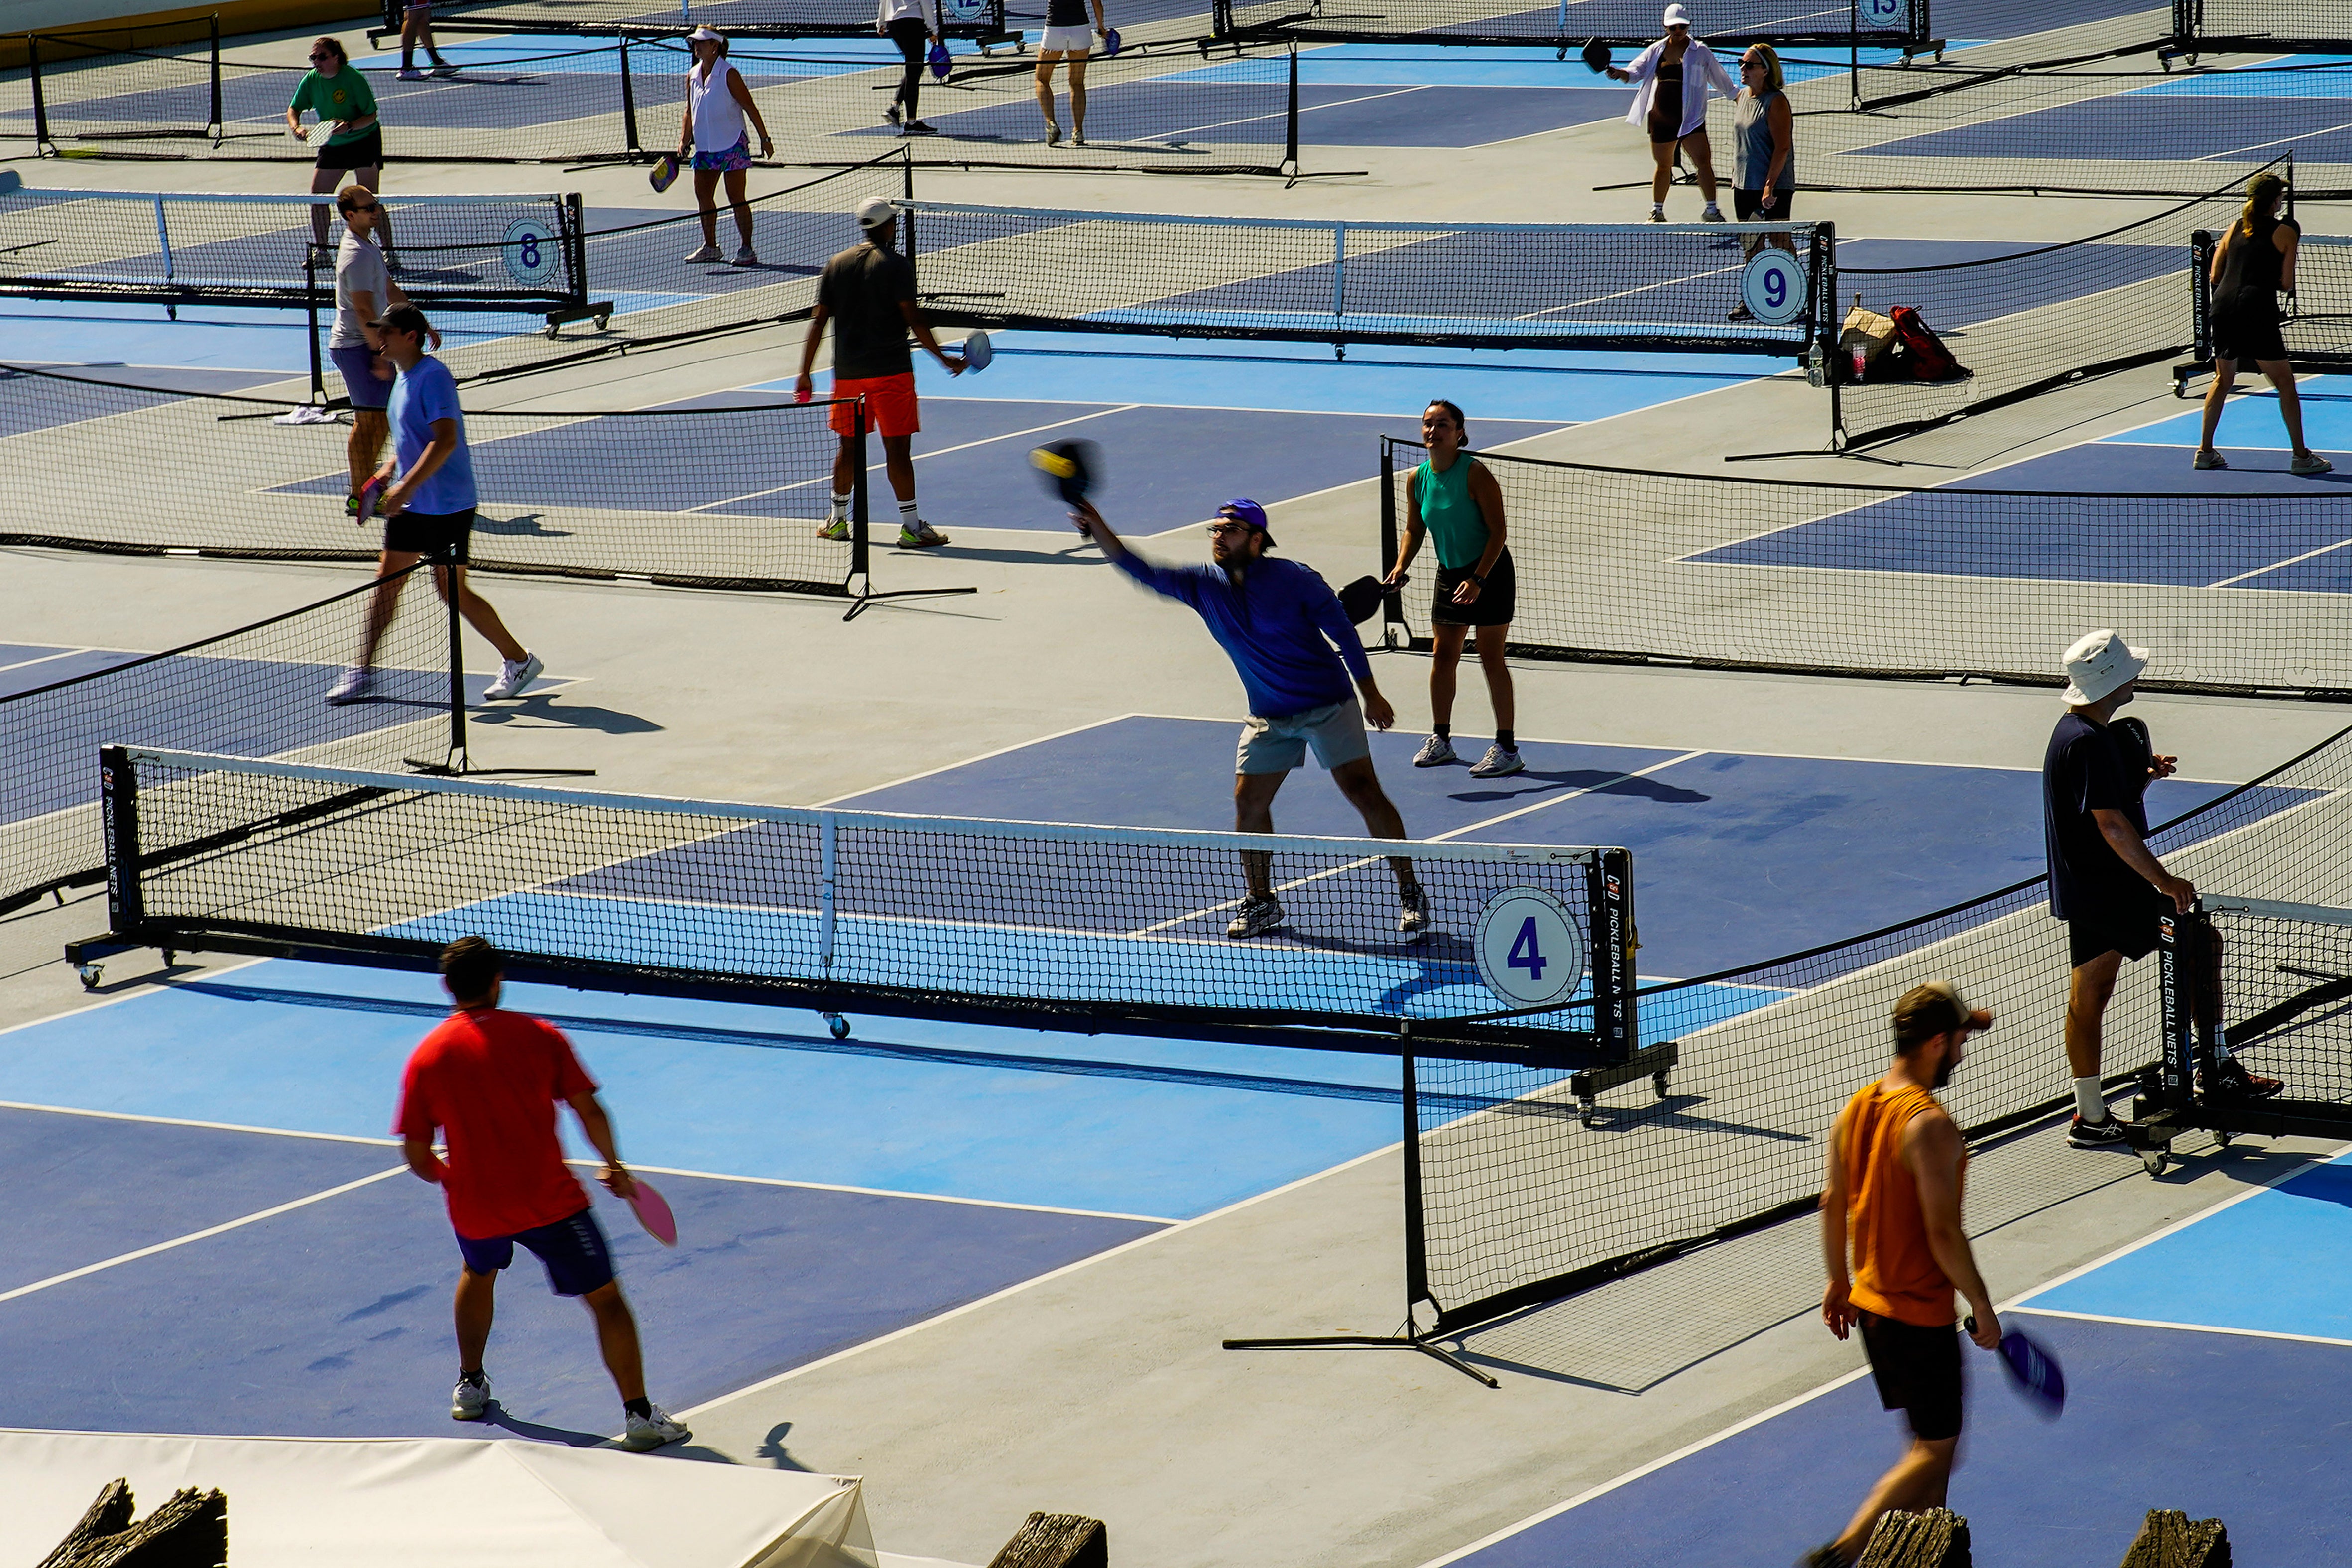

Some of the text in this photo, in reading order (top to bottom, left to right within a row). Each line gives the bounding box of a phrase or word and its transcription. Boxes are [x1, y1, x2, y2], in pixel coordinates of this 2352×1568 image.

[521, 233, 541, 268] 8
[1764, 268, 1786, 308] 9
[106, 796, 116, 862] PICKLEBALL
[109, 865, 118, 895] NETS
[1507, 916, 1547, 980] 4
[1607, 875, 1622, 1018] C&D PICKLEBALL NTS
[2160, 916, 2177, 1065] C&D PICKLEBALL NETS
